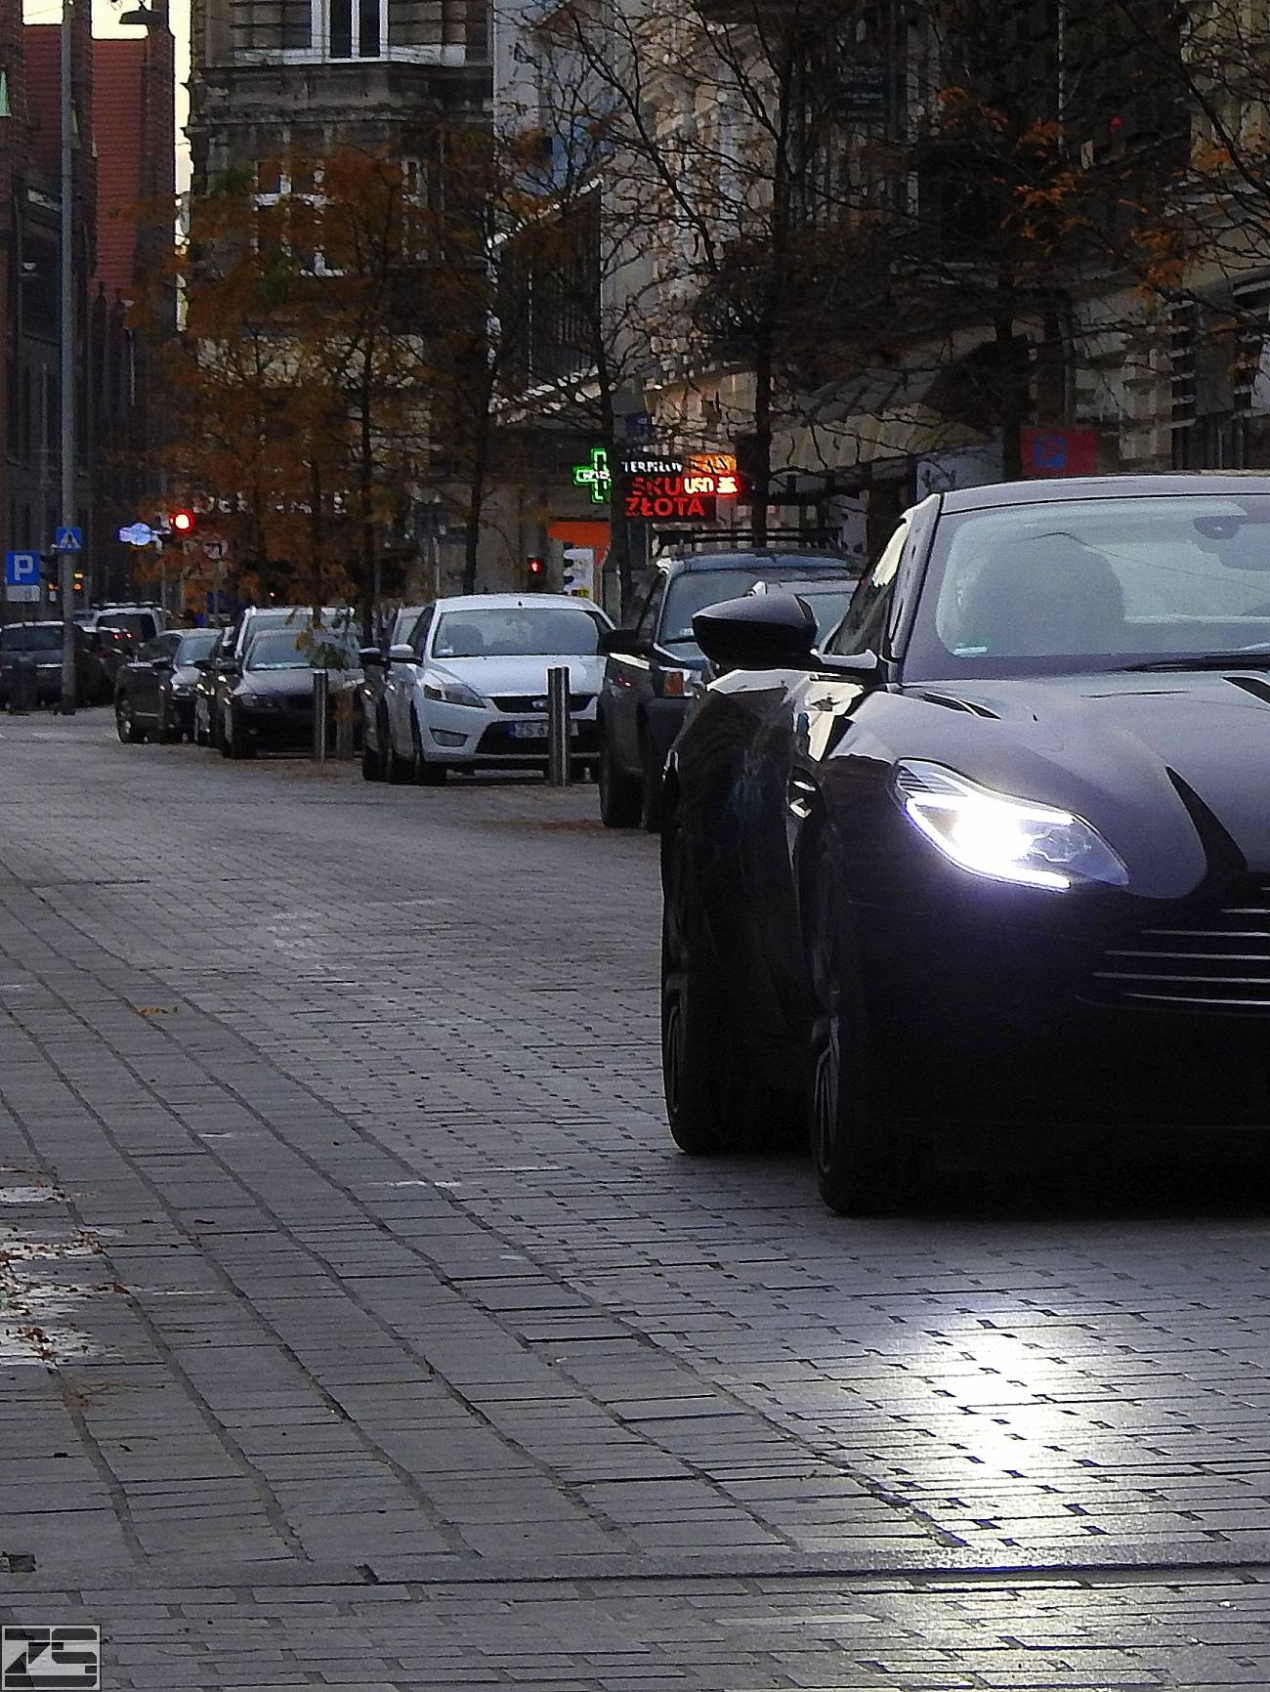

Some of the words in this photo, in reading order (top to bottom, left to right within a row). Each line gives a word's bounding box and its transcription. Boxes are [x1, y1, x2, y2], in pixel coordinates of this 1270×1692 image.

[631, 476, 682, 496] SKU
[625, 496, 706, 517] ZŁOTA
[13, 554, 34, 581] P
